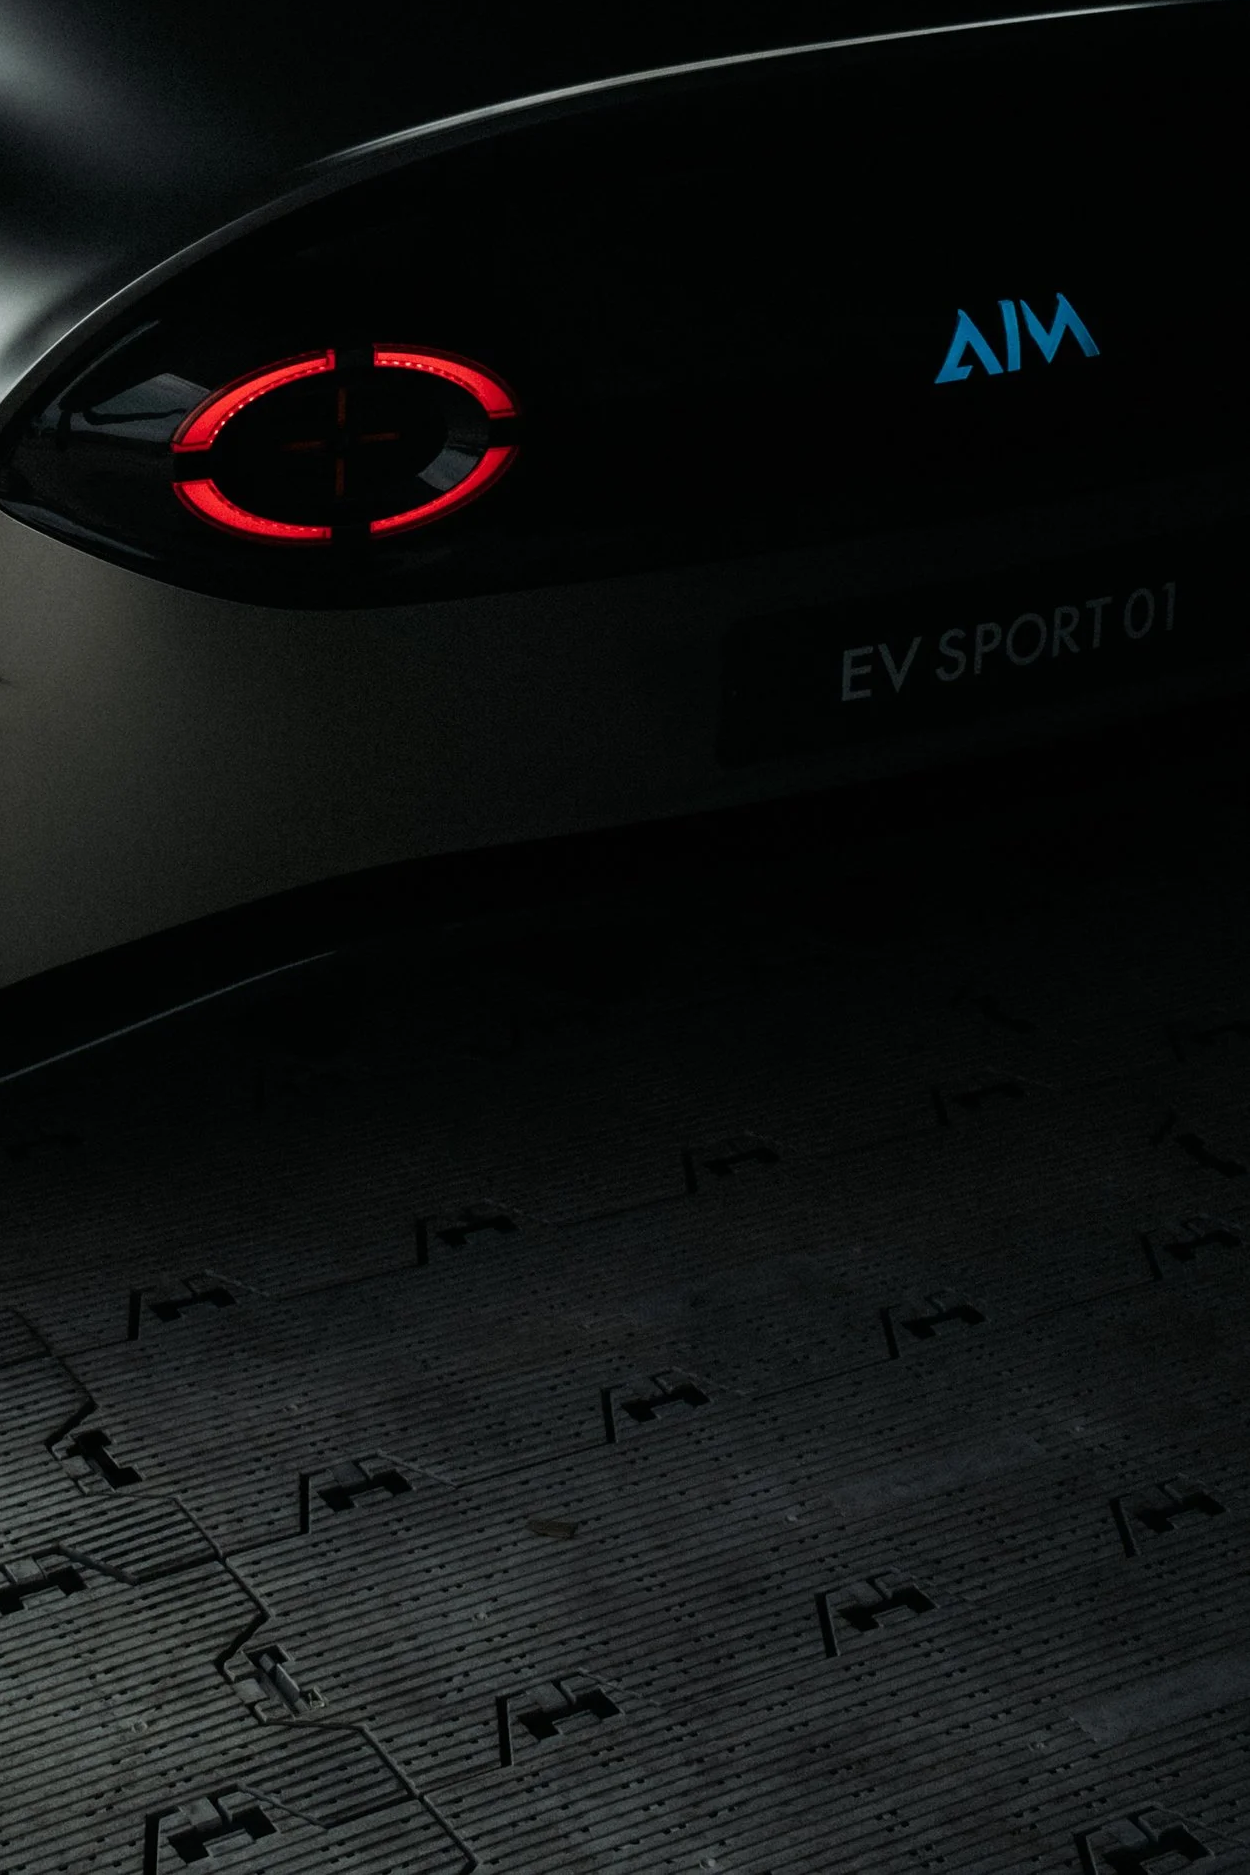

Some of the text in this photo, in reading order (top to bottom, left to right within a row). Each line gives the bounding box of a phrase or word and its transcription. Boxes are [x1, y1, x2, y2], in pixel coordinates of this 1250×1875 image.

[934, 291, 1100, 384] AIM
[841, 581, 1176, 702] EV SPORT 01
